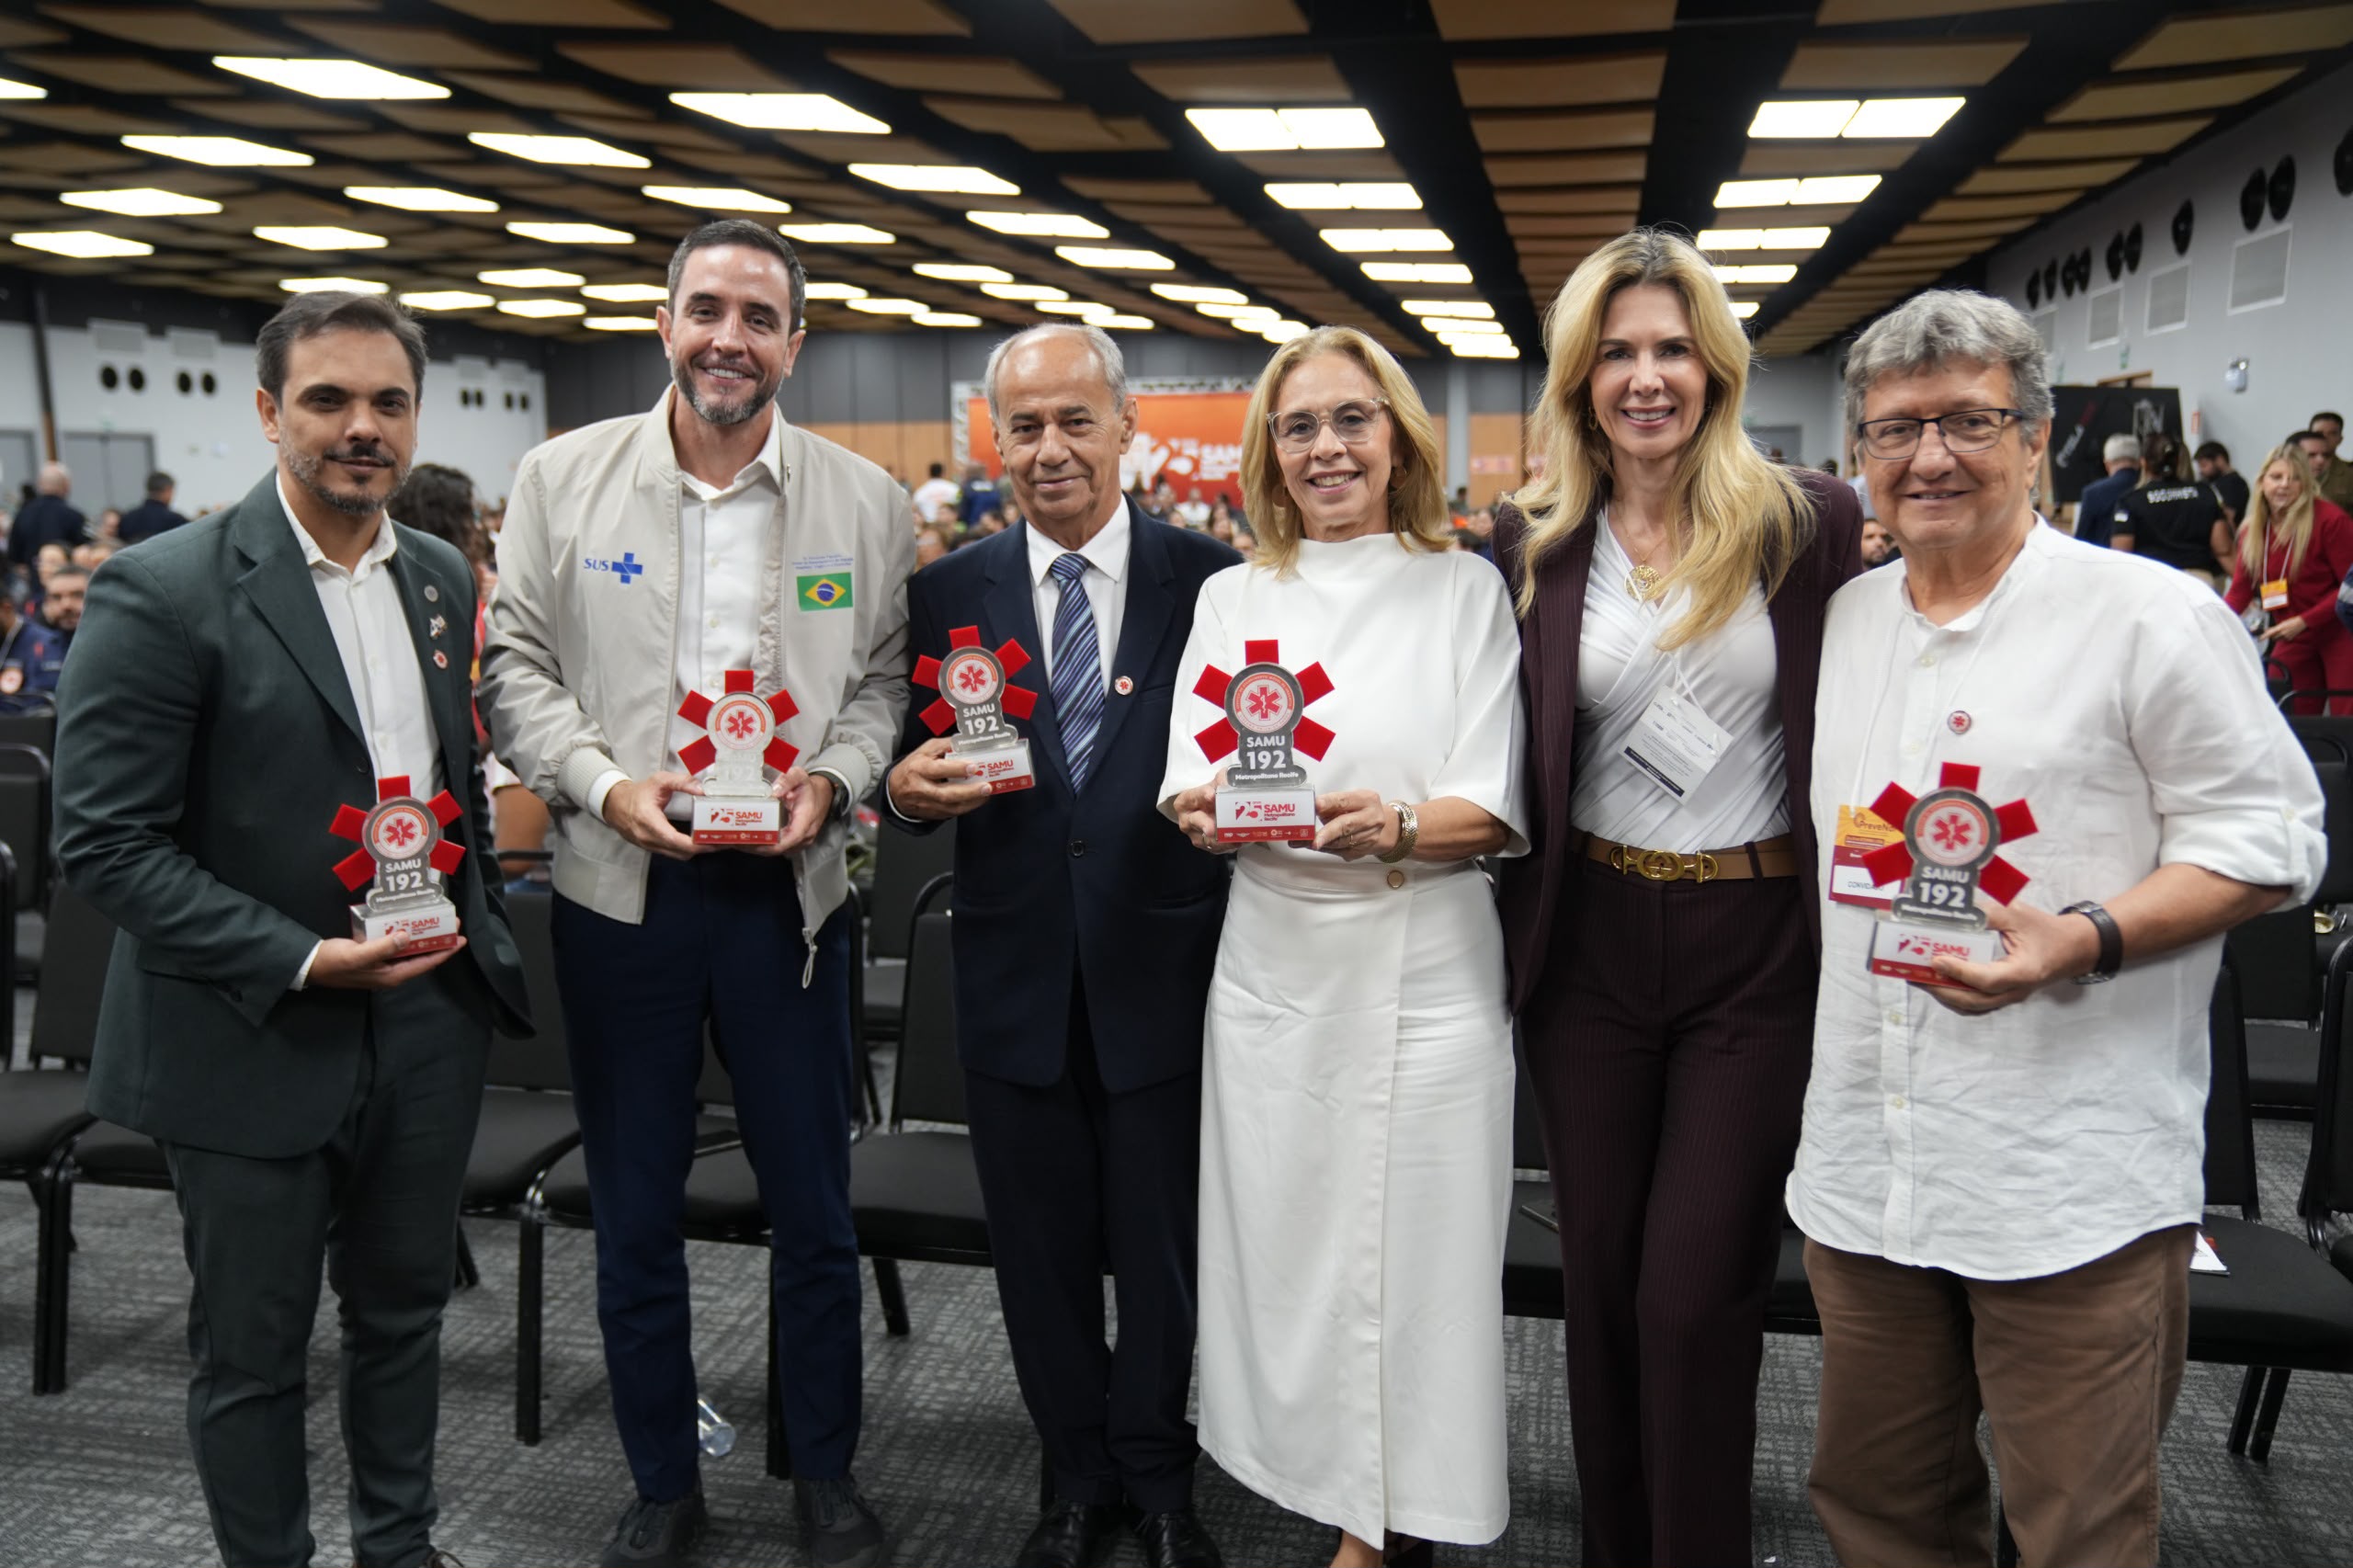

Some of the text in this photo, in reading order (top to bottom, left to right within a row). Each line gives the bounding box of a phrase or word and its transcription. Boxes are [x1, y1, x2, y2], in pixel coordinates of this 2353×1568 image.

[584, 558, 608, 572] SUS
[962, 703, 995, 718] SAMU
[965, 717, 999, 735] 192
[1246, 735, 1286, 748] SAMU
[987, 760, 1014, 770] SAMU
[1246, 750, 1286, 769] 192
[1235, 771, 1299, 781] Metropolitano Recife
[1264, 803, 1295, 812] SAMU
[385, 858, 422, 873] SAMU
[386, 873, 423, 892] 192
[1922, 866, 1970, 884] SAMU
[1919, 883, 1965, 908] 192
[411, 917, 439, 928] SAMU
[1932, 942, 1971, 957] SAMU
